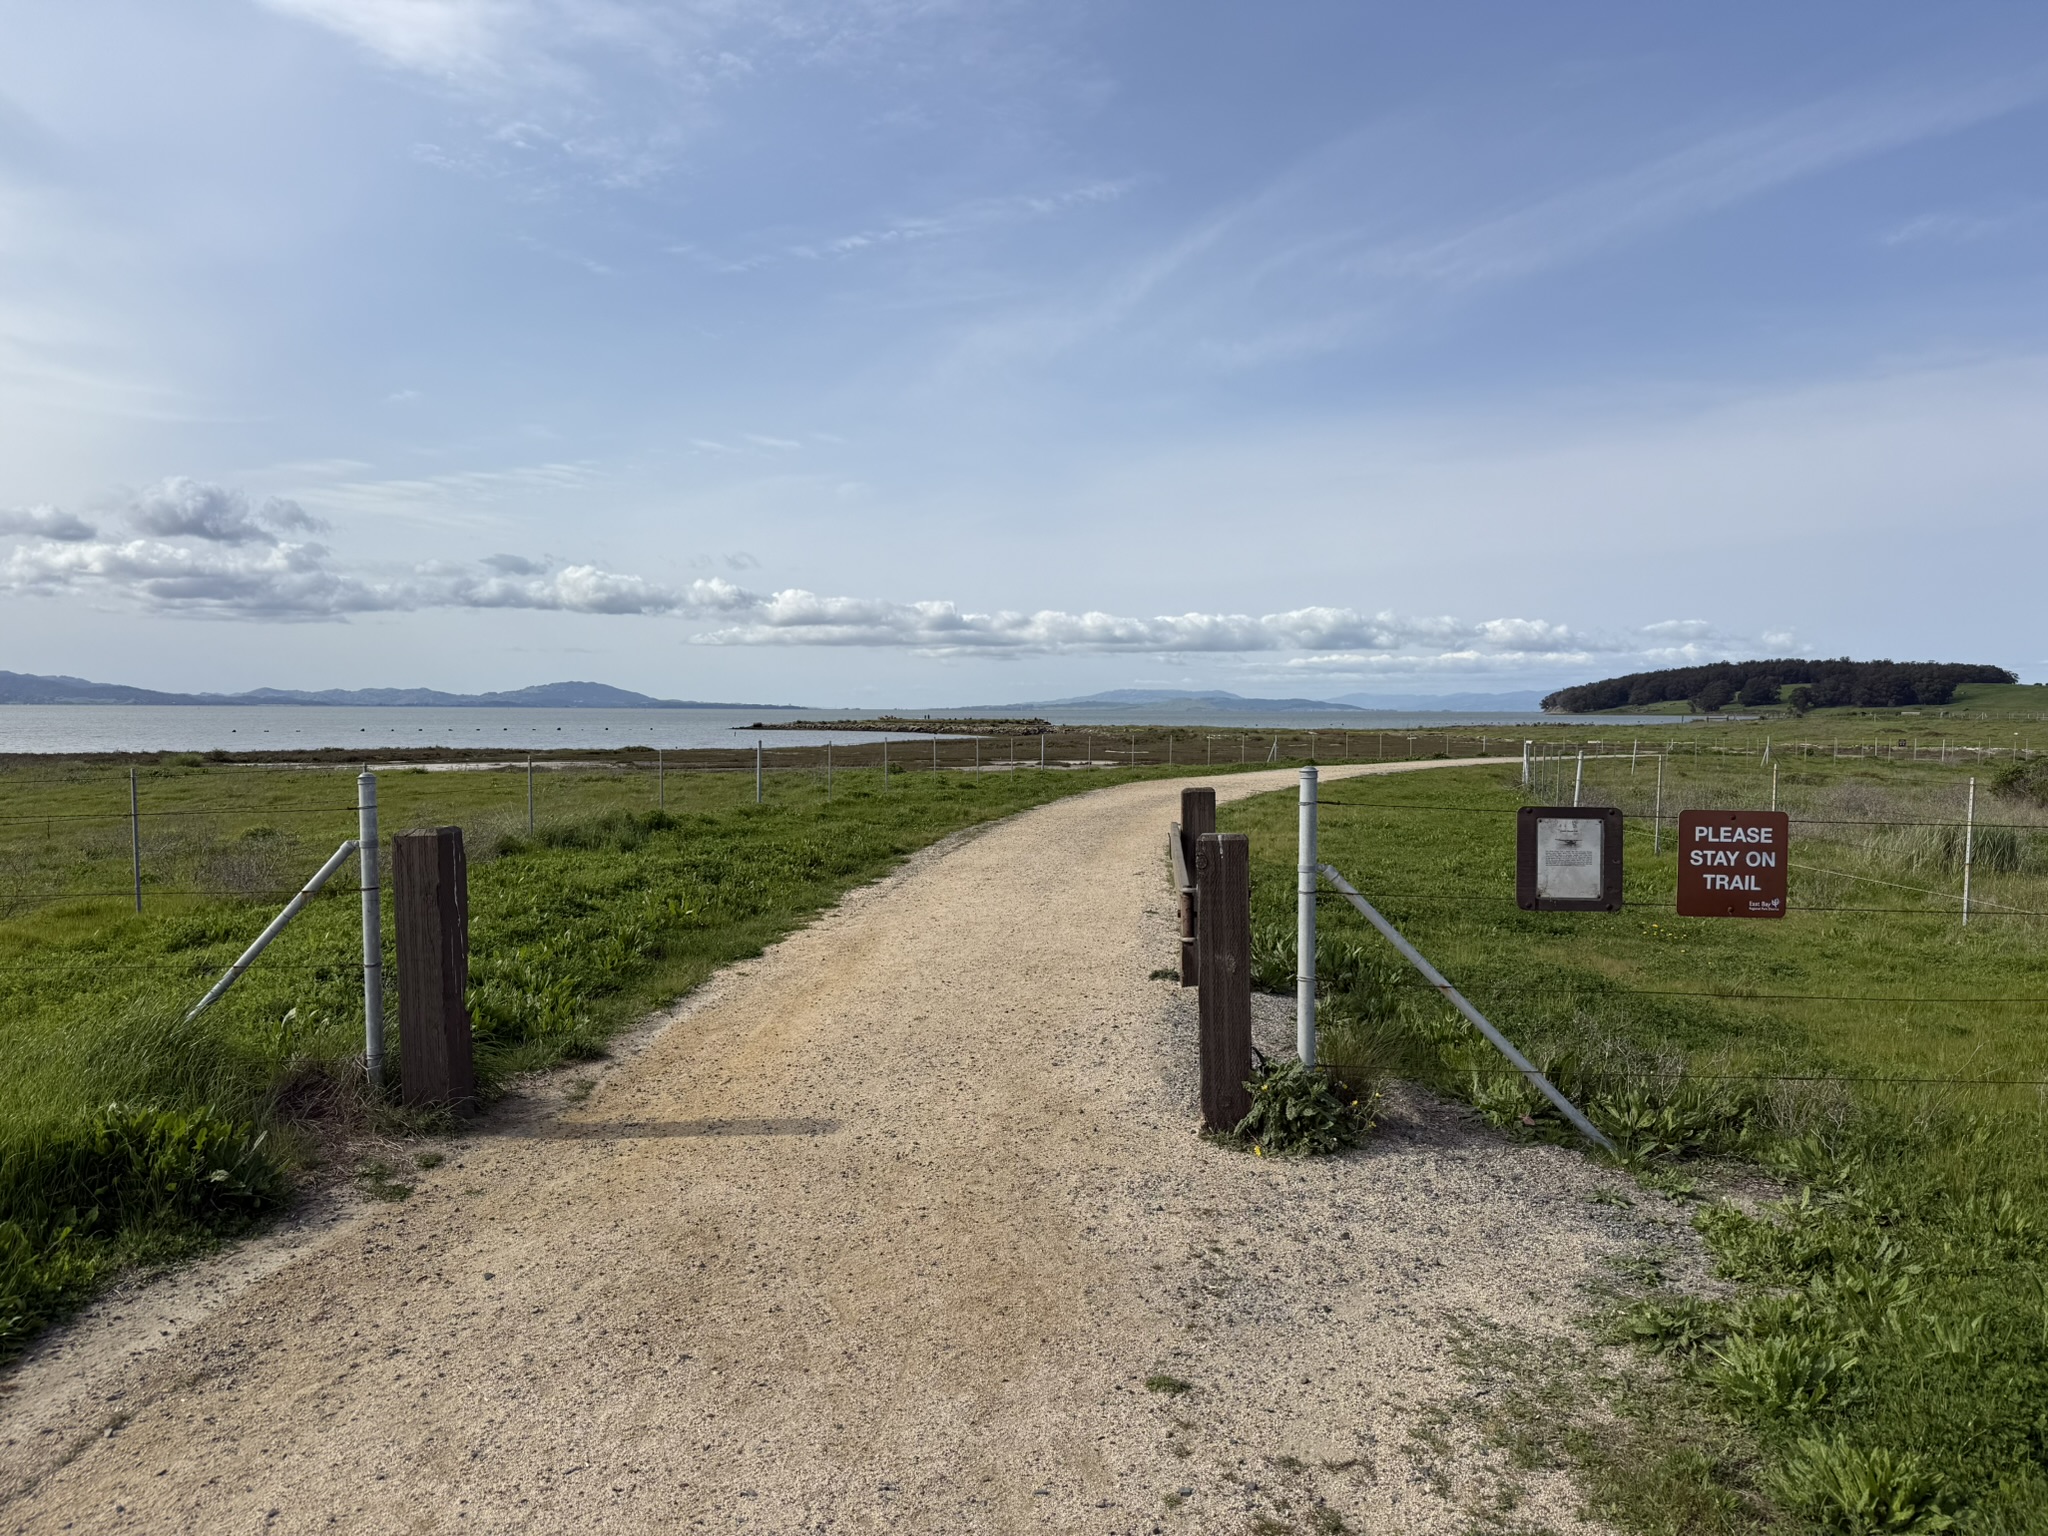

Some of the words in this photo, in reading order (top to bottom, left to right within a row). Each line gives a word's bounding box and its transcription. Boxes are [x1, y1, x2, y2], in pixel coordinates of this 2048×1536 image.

[1695, 826, 1773, 843] PLEASE
[1690, 850, 1740, 867] STAY
[1745, 851, 1776, 867] ON
[1703, 874, 1761, 891] TRAIL
